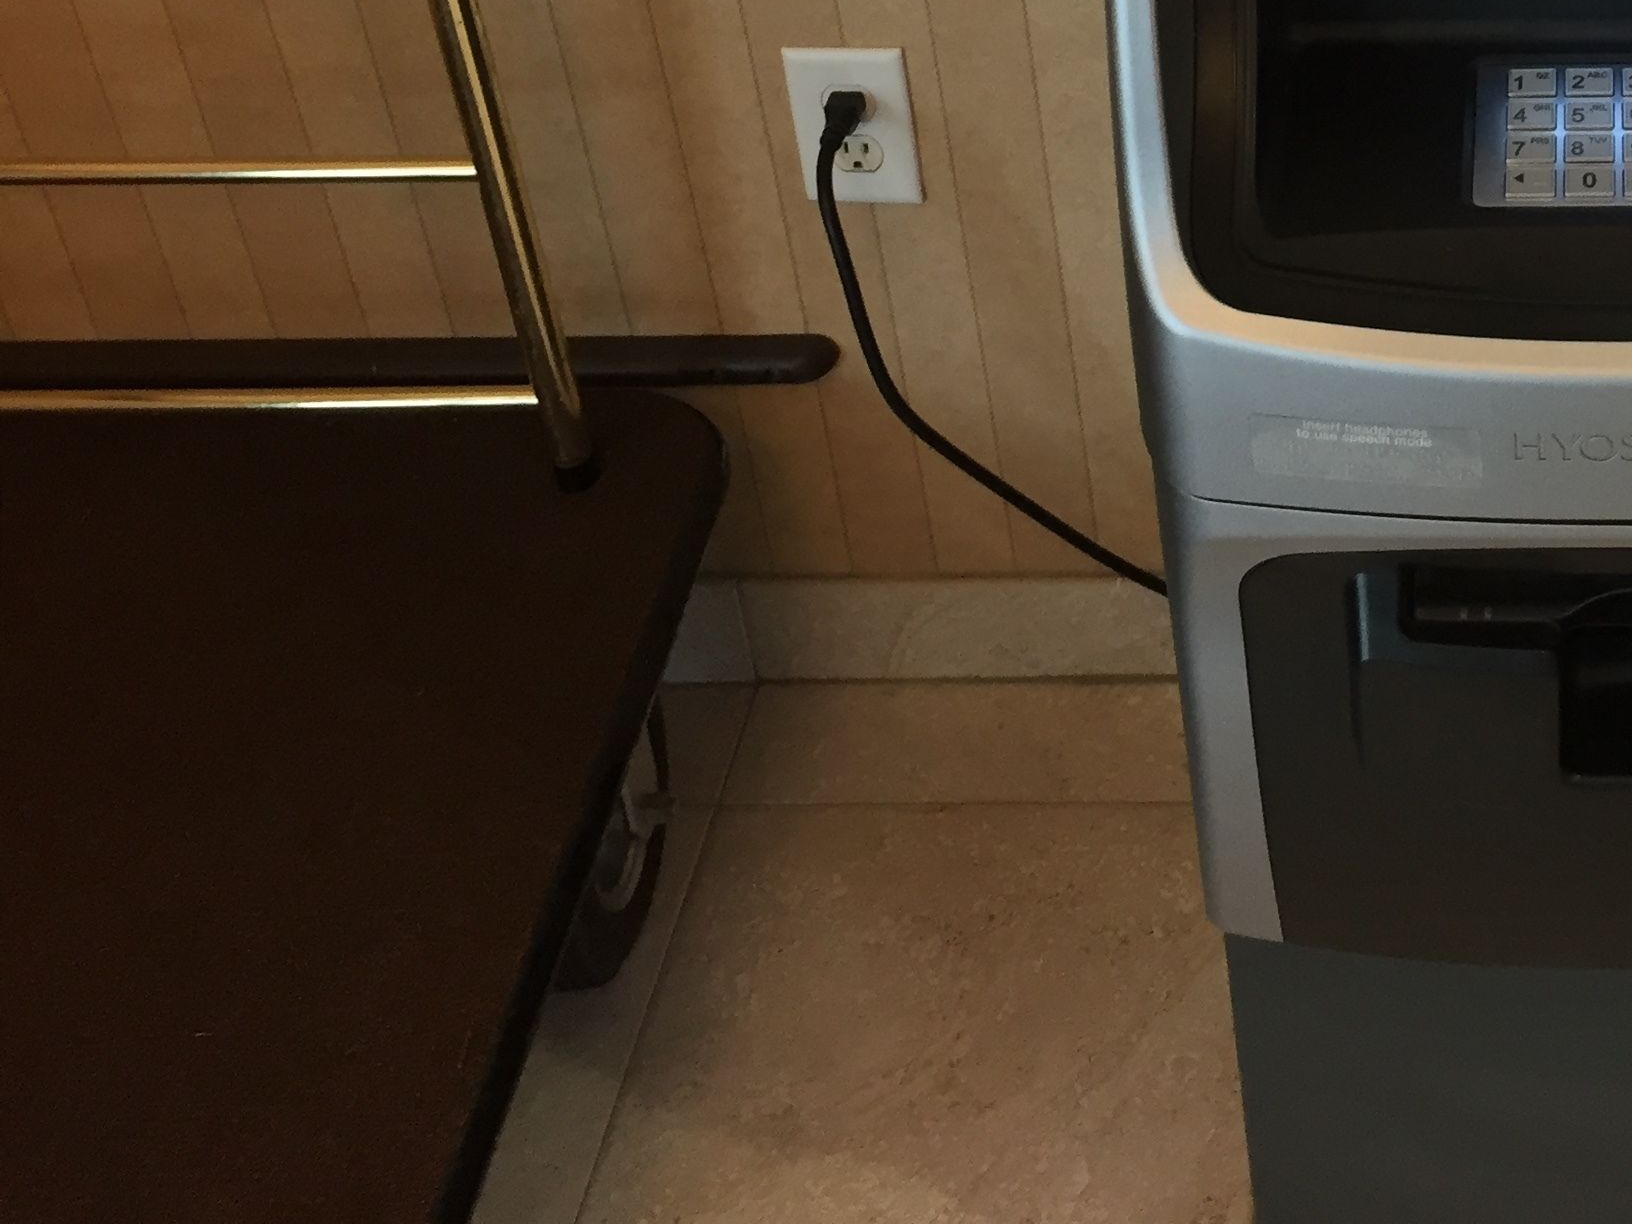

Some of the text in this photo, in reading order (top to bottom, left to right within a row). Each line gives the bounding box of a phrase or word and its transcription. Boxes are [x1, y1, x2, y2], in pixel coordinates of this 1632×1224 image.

[1571, 74, 1585, 89] 2
[1512, 107, 1528, 123] 4
[1571, 107, 1585, 123] 5
[1512, 140, 1526, 156] 7
[1571, 140, 1585, 155] 8
[1582, 172, 1597, 188] 0
[1296, 428, 1433, 448] to use speech mode
[1344, 423, 1429, 438] headphones
